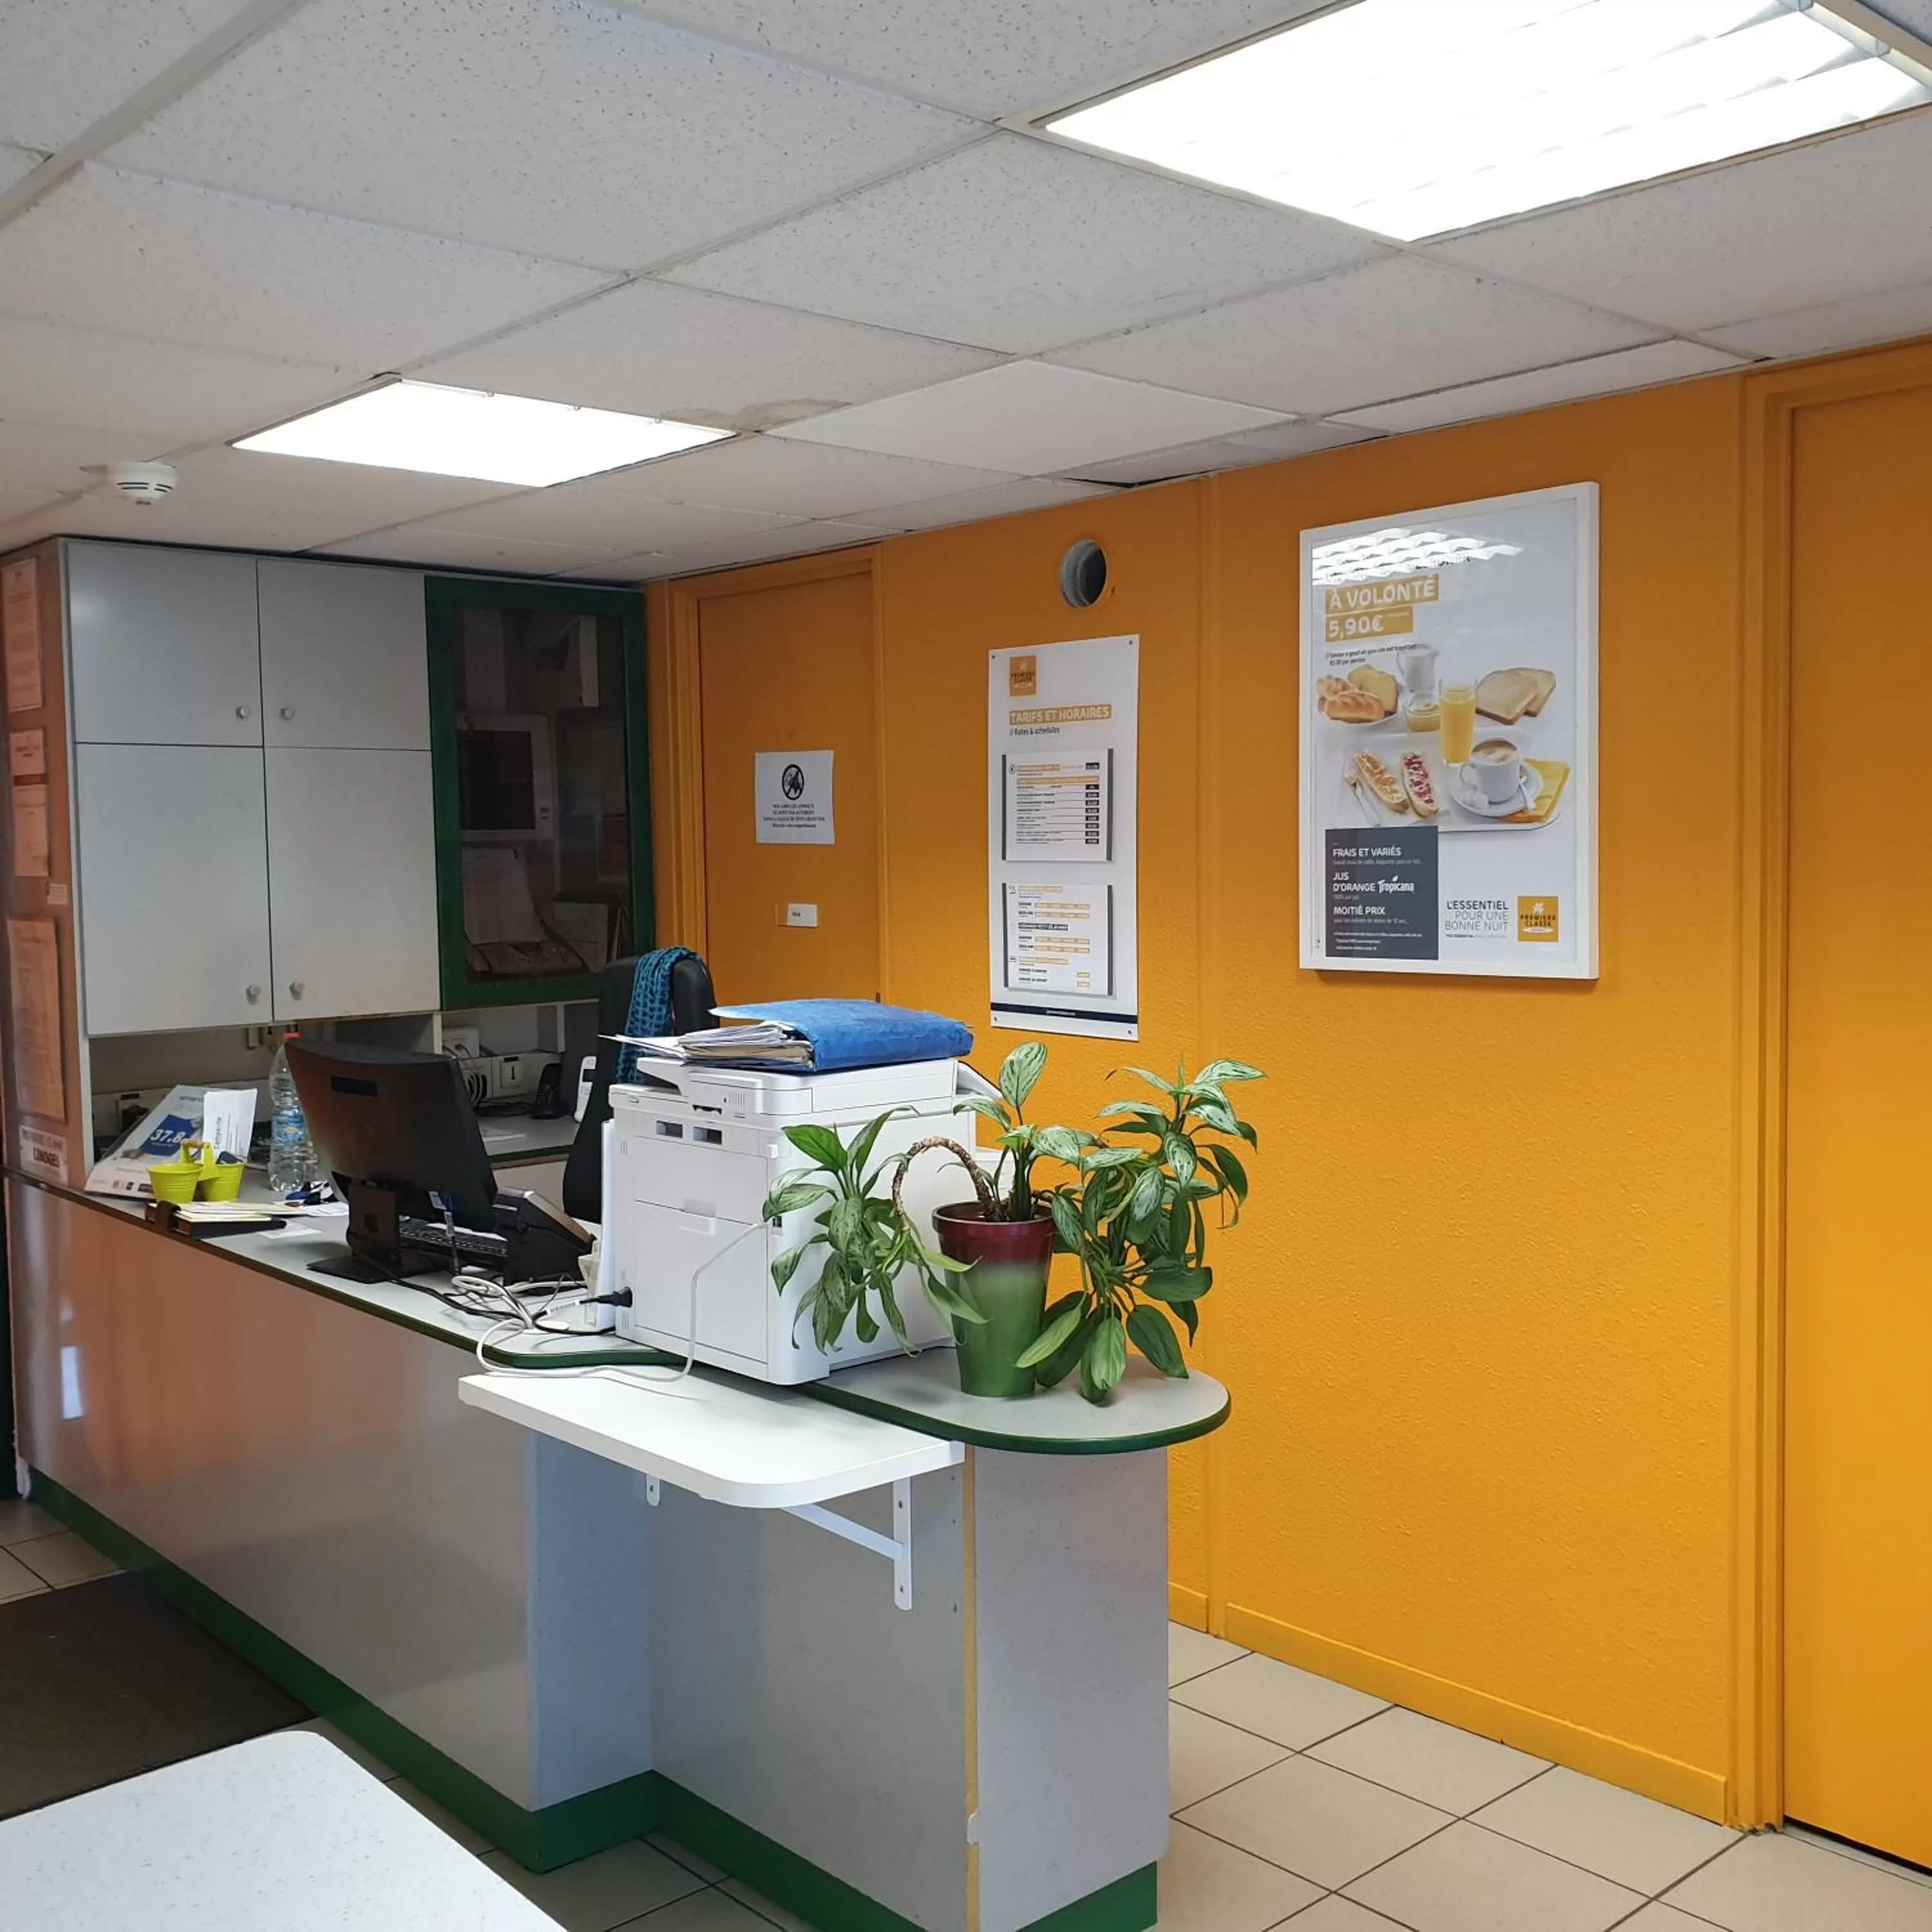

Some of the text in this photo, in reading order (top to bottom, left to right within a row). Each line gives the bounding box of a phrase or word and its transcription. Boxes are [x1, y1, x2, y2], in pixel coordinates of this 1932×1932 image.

[1347, 574, 1435, 608] VOLONTÉ
[1329, 614, 1384, 639] 5,90€
[1010, 705, 1110, 724] TARIFS ET HORAIRES
[1332, 845, 1402, 857] FRAIS ET VARIÉS
[1332, 871, 1349, 880] JUS
[1332, 876, 1415, 894] D'ORANGE Tropicana
[1333, 904, 1386, 915] MOITIÉ PRIX
[1446, 900, 1509, 910] L'ESSENTIEL
[1455, 911, 1509, 921] POUR UNE
[1444, 920, 1510, 931] BONNE NUIT
